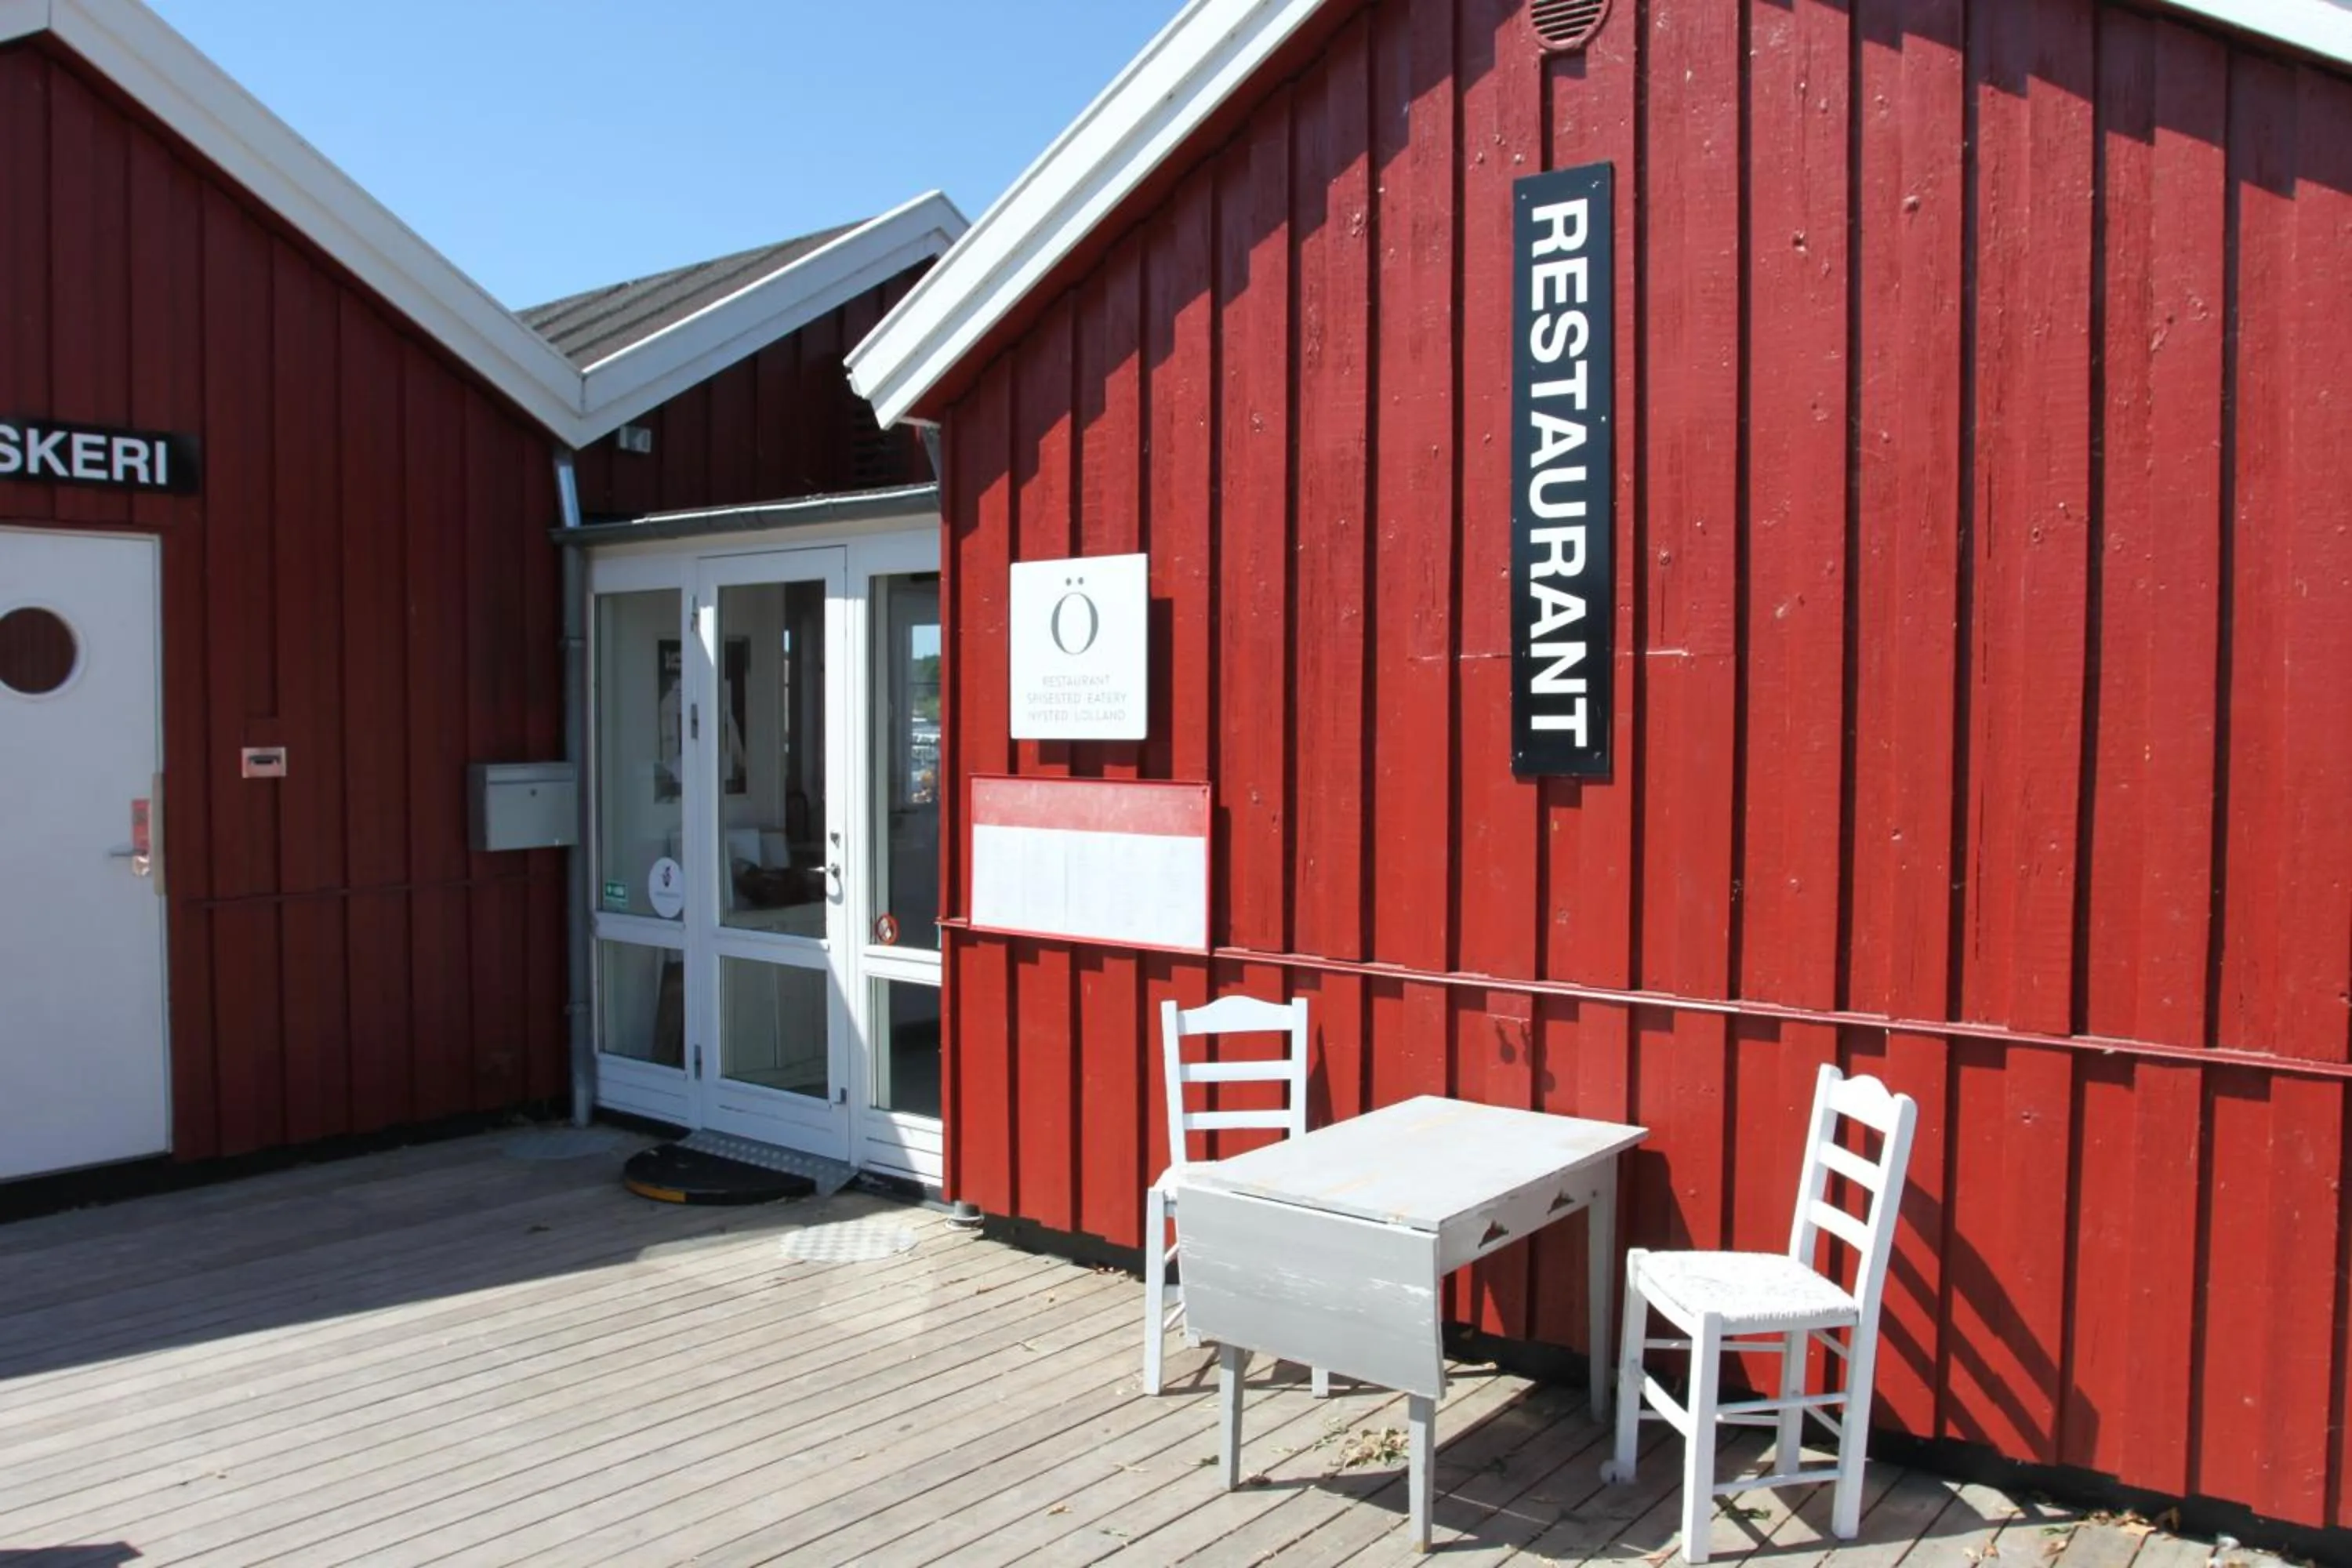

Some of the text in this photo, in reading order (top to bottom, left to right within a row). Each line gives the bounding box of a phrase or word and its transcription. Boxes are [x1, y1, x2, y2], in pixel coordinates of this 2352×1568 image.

[0, 423, 168, 485] SKERI
[1527, 198, 1591, 748] RESTAURANT
[1051, 576, 1099, 655] Ö
[1041, 674, 1110, 688] RESTAURANT
[1087, 691, 1127, 704] EATERY
